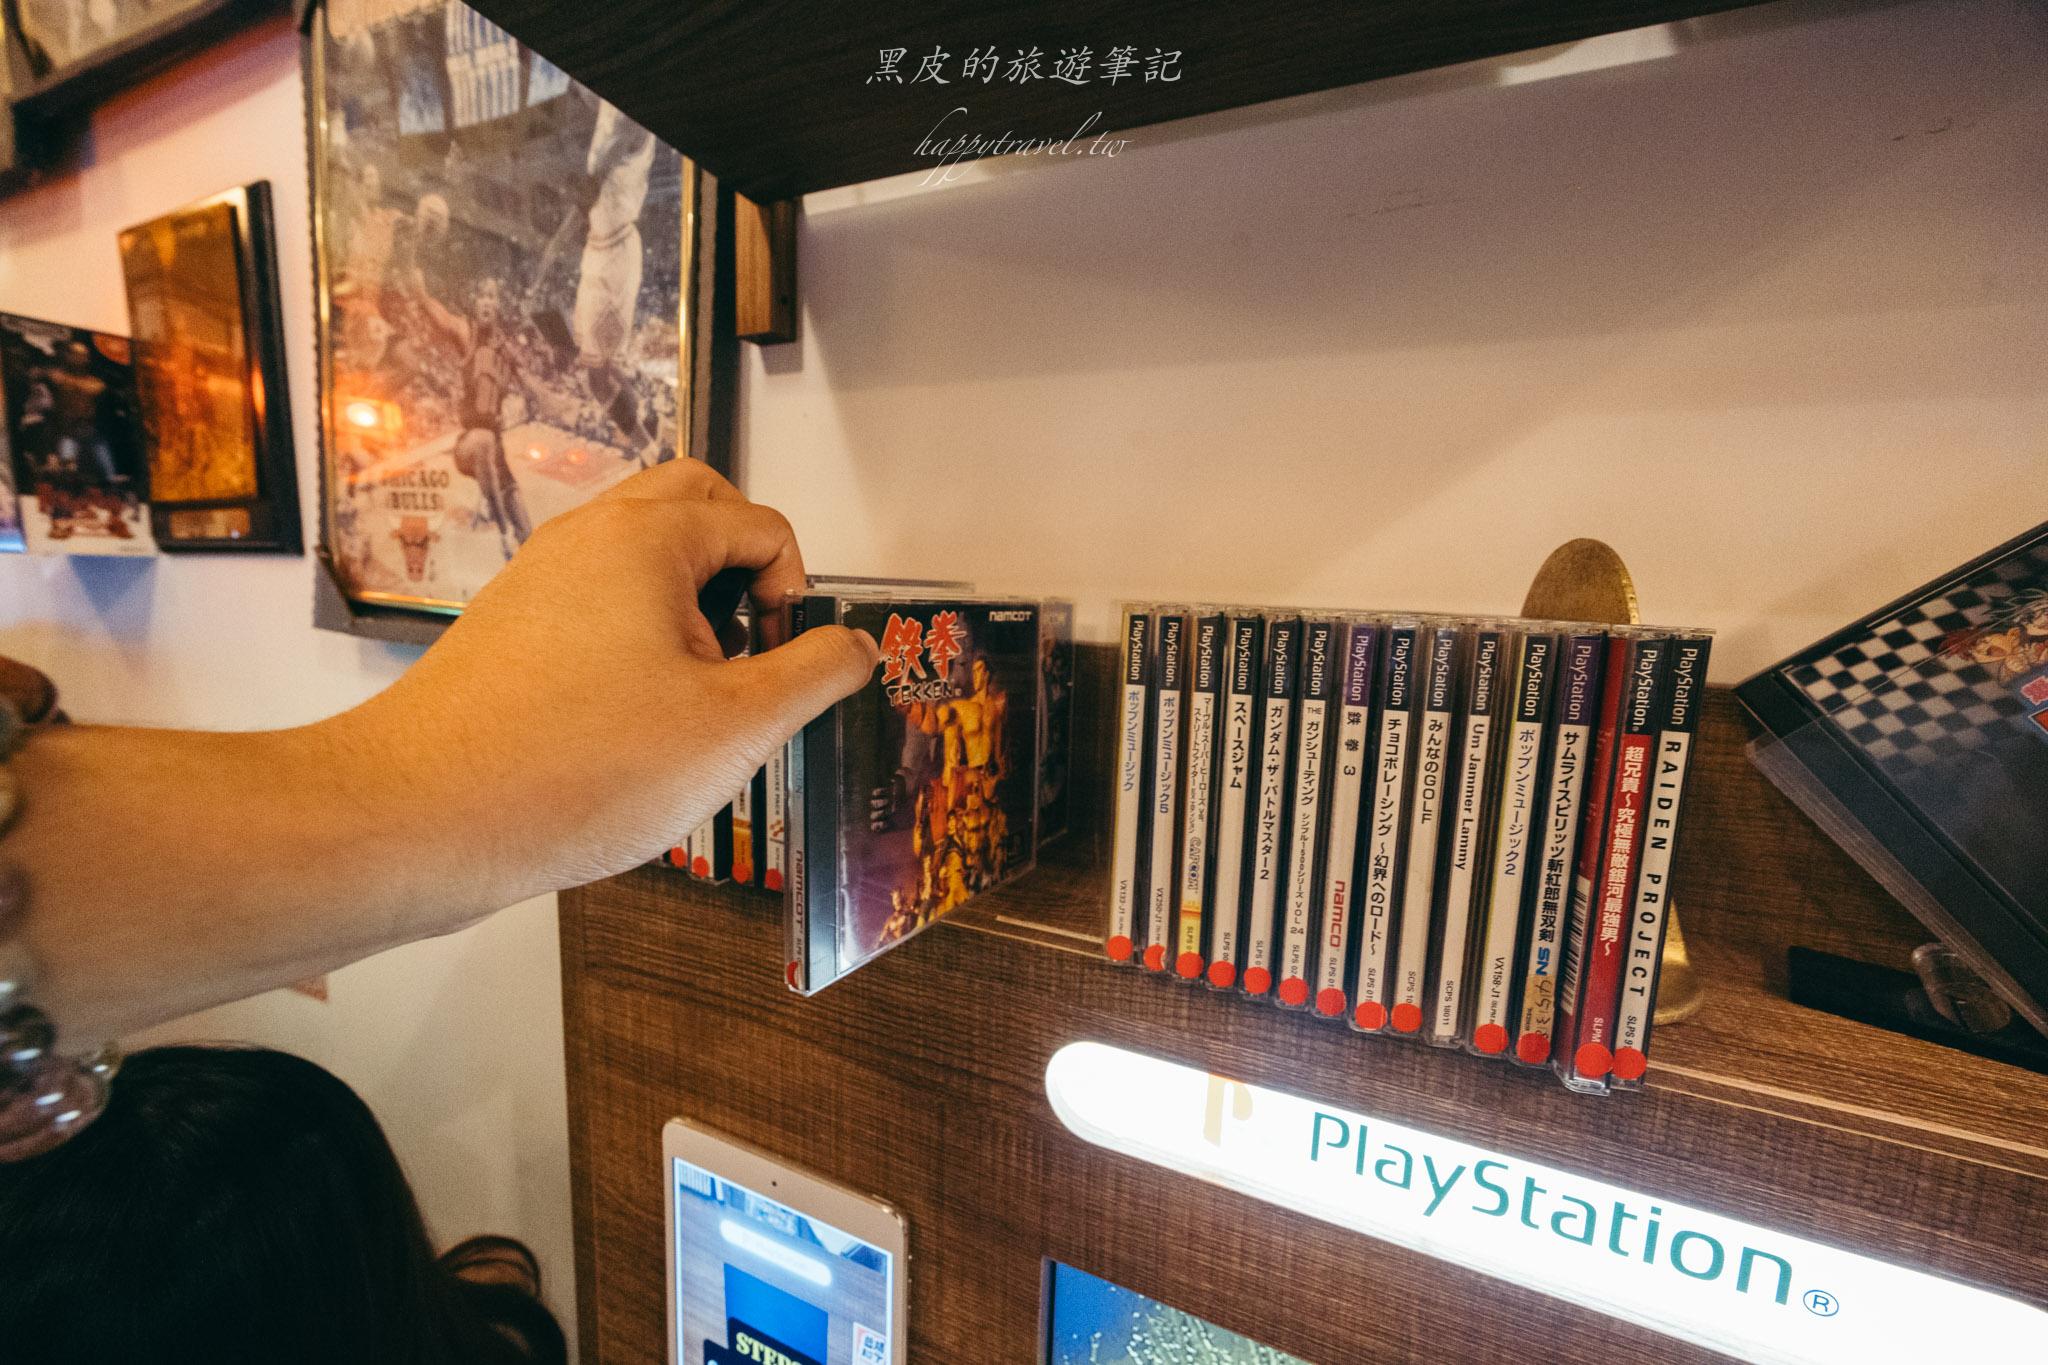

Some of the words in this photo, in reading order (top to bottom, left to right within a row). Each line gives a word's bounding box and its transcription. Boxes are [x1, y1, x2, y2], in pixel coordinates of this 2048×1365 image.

[1130, 620, 1145, 681] PlayStation
[1164, 621, 1179, 683] PlayStation
[1198, 625, 1214, 688] PlayStation
[1236, 627, 1253, 690] PlayStation
[1273, 630, 1290, 694] PlayStation
[1310, 630, 1328, 696] PlayStation
[1351, 635, 1369, 701] PlayStation
[1391, 638, 1410, 706] PlayStation
[1433, 639, 1453, 707] PlayStation
[1475, 640, 1495, 711] PlayStation
[1525, 644, 1547, 717] PlayStation
[1568, 645, 1592, 720] PlayStation
[886, 678, 954, 707] TEKKEN
[1307, 706, 1322, 715] THE
[1633, 649, 1657, 726] PlayStation
[1671, 648, 1698, 725] PlayStation
[1230, 701, 1247, 789] スペースジャム
[1300, 720, 1320, 806] ガンシューティング
[1471, 723, 1485, 749] Um
[1421, 719, 1444, 824] みんなのGOLF
[1463, 754, 1481, 813] Jammer
[1651, 740, 1682, 850] RAIDEN
[1455, 817, 1474, 870] Lammy
[1330, 880, 1346, 948] namco
[1630, 873, 1662, 997] PROJECT
[1535, 946, 1550, 976] SN
[1591, 1017, 1604, 1043] SLPM
[1625, 1015, 1637, 1036] SLPS
[1311, 1111, 1794, 1305] PlayStation
